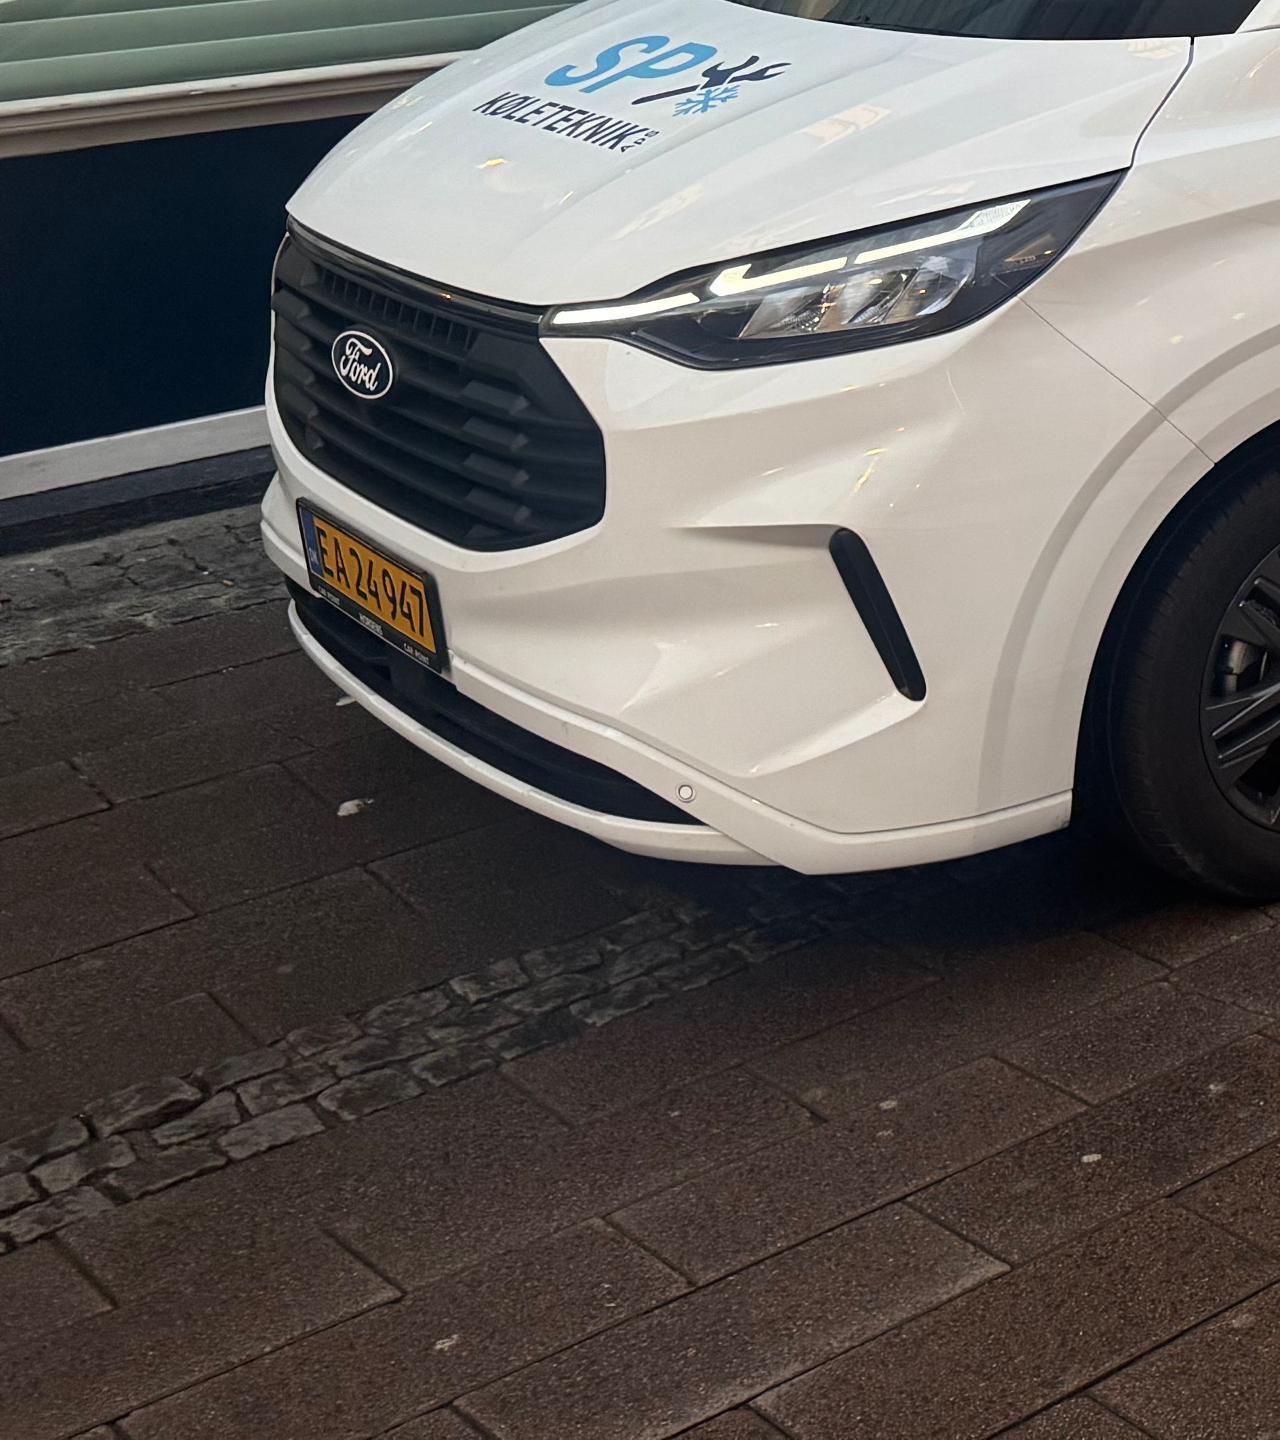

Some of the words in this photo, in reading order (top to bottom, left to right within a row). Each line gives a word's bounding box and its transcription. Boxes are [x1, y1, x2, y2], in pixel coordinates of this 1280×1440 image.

[544, 35, 718, 94] SP
[472, 91, 649, 151] KØLETEKNIK
[340, 336, 378, 392] Ford
